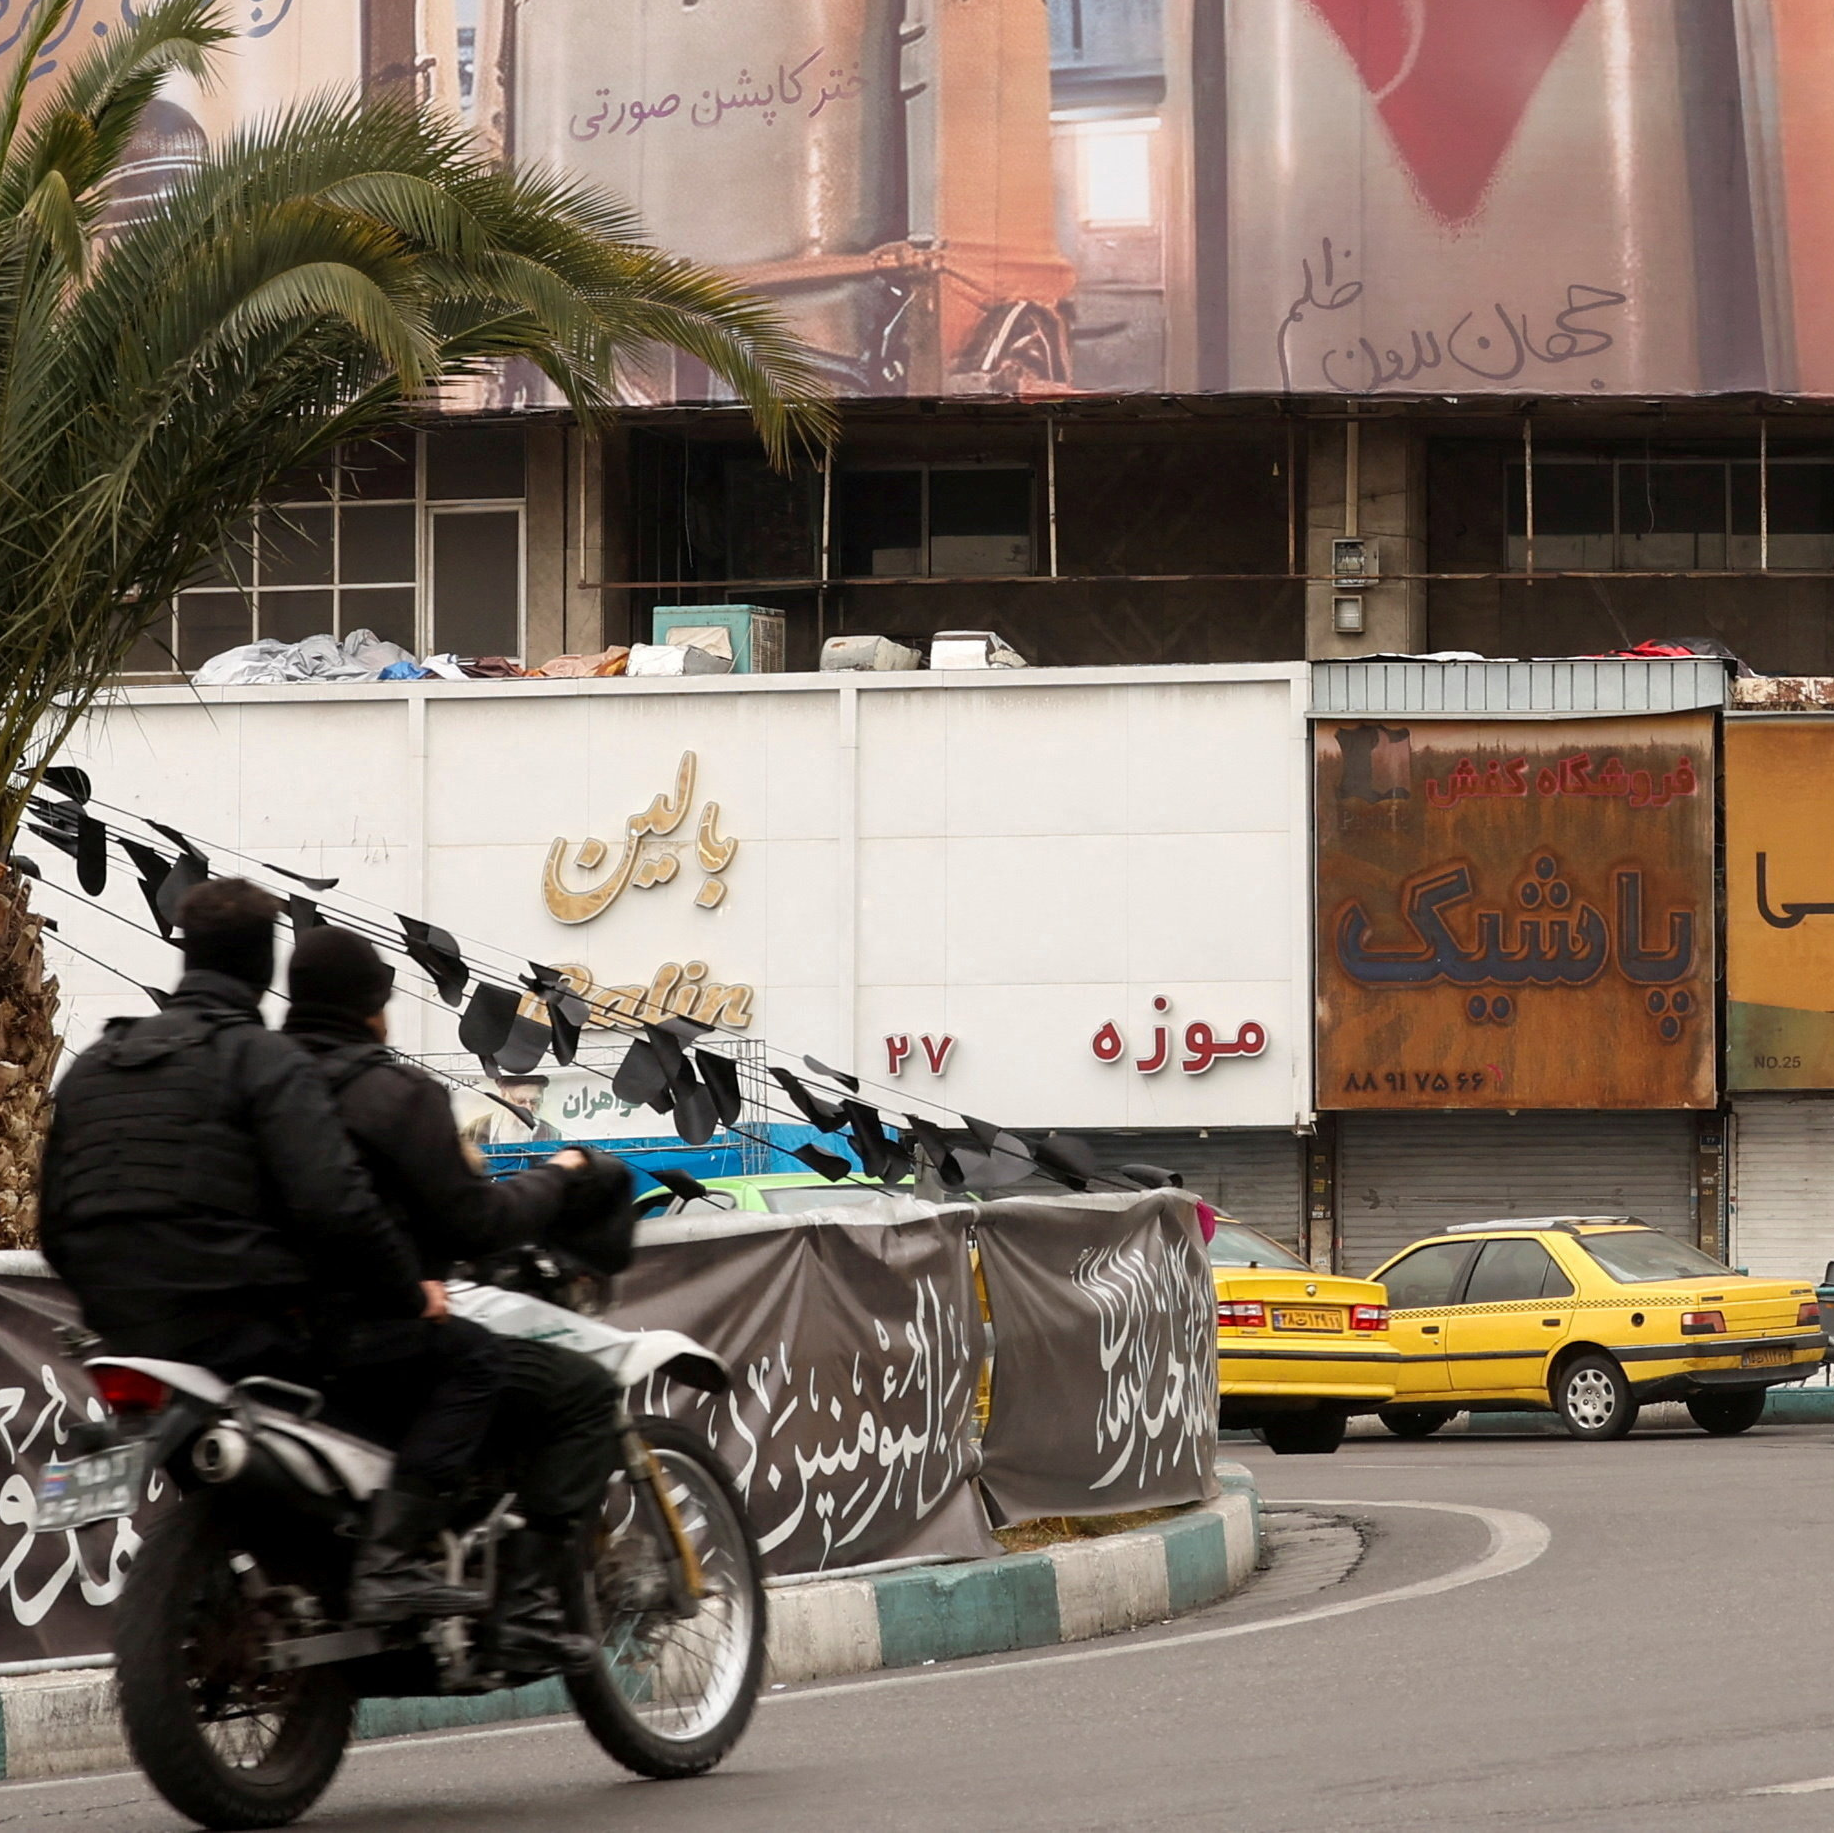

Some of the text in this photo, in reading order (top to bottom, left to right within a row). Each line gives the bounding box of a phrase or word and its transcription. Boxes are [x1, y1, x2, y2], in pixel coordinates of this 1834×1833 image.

[690, 46, 824, 126] کاپشن
[569, 89, 681, 141] صورتی
[1425, 753, 1698, 808] فروشگاه کفش
[541, 749, 740, 926] بالین
[1333, 856, 1694, 1042] پاشیک
[883, 1032, 959, 1078] ۲۷
[1090, 994, 1271, 1078] موزه
[1754, 1056, 1801, 1069] NO.25
[1344, 1071, 1486, 1092] ۸۸ ۹۱ ۷۵ ۶۶
